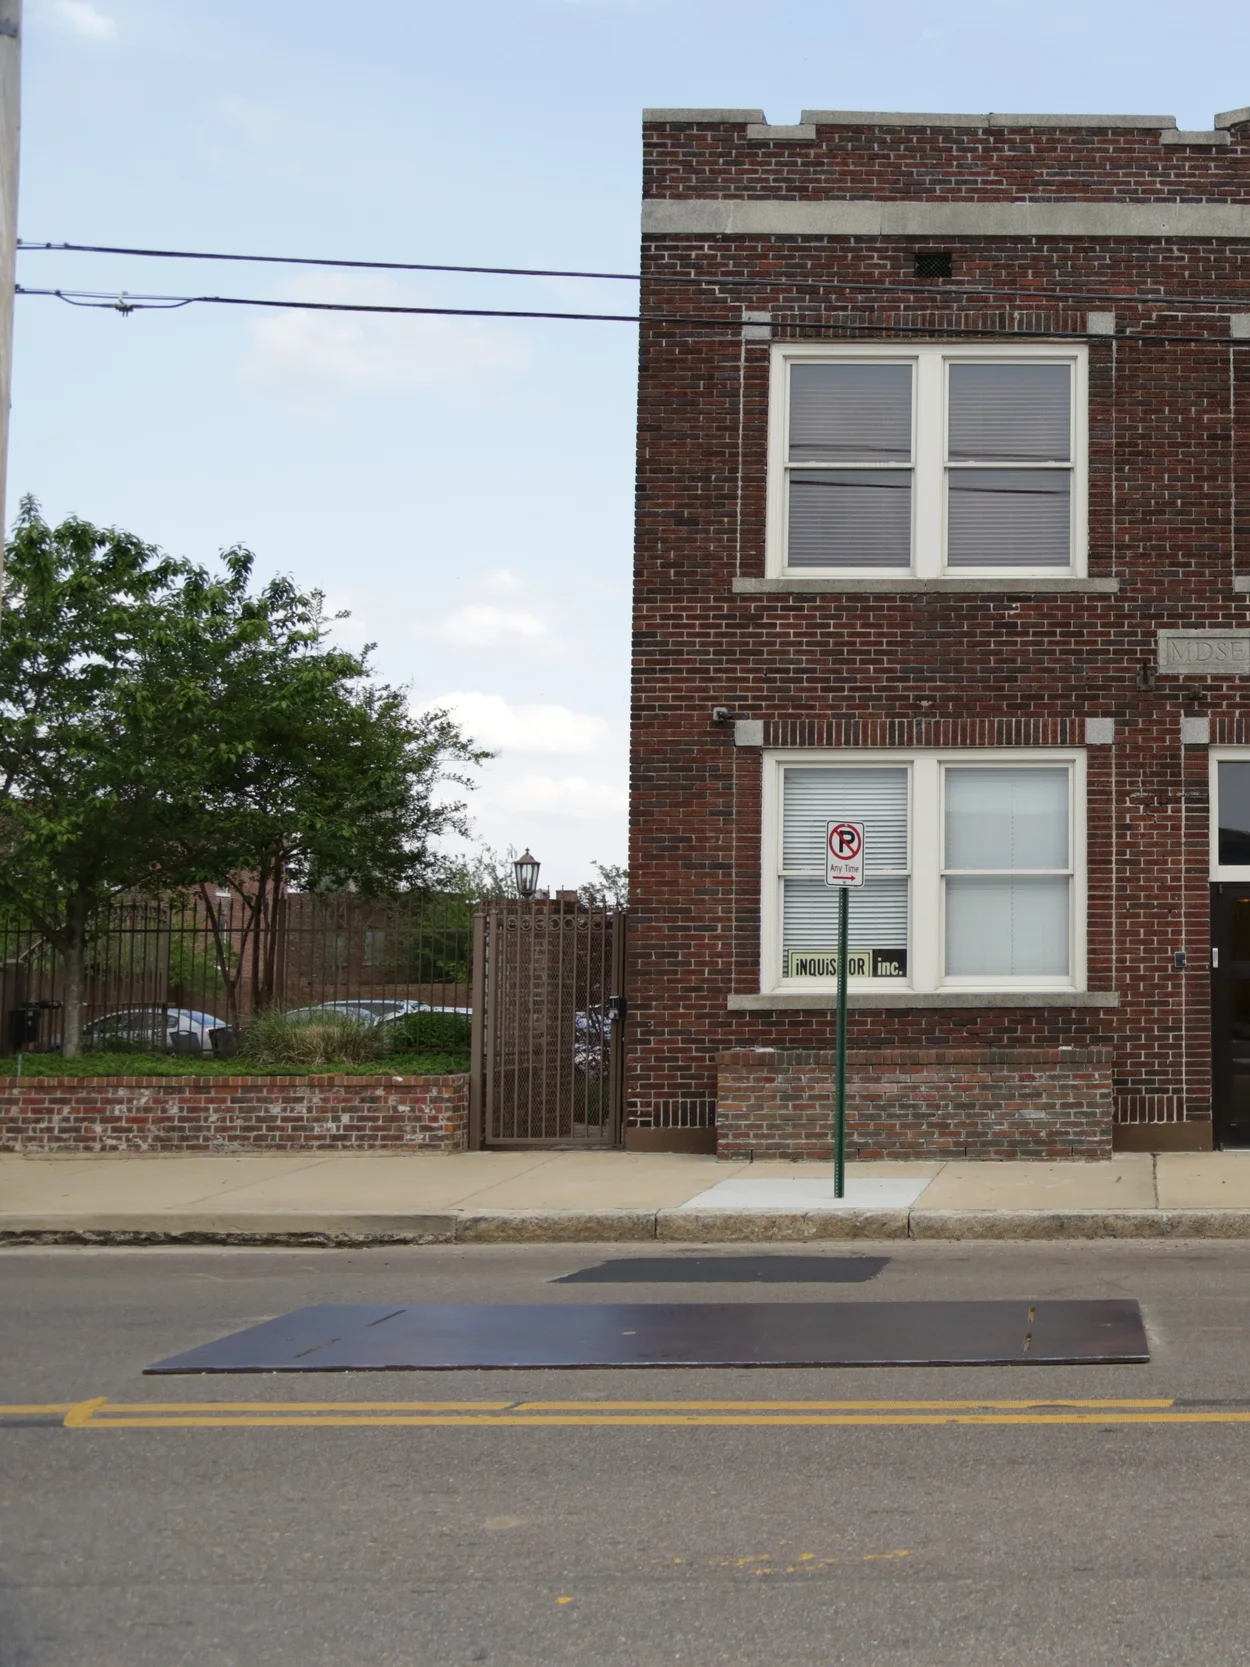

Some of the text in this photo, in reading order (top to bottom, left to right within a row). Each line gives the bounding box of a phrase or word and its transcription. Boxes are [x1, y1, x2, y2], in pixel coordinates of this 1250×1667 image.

[1171, 641, 1245, 662] MDSE
[839, 830, 855, 853] P
[830, 864, 859, 874] Any Time
[796, 957, 903, 976] iNQUiSOR inc.
